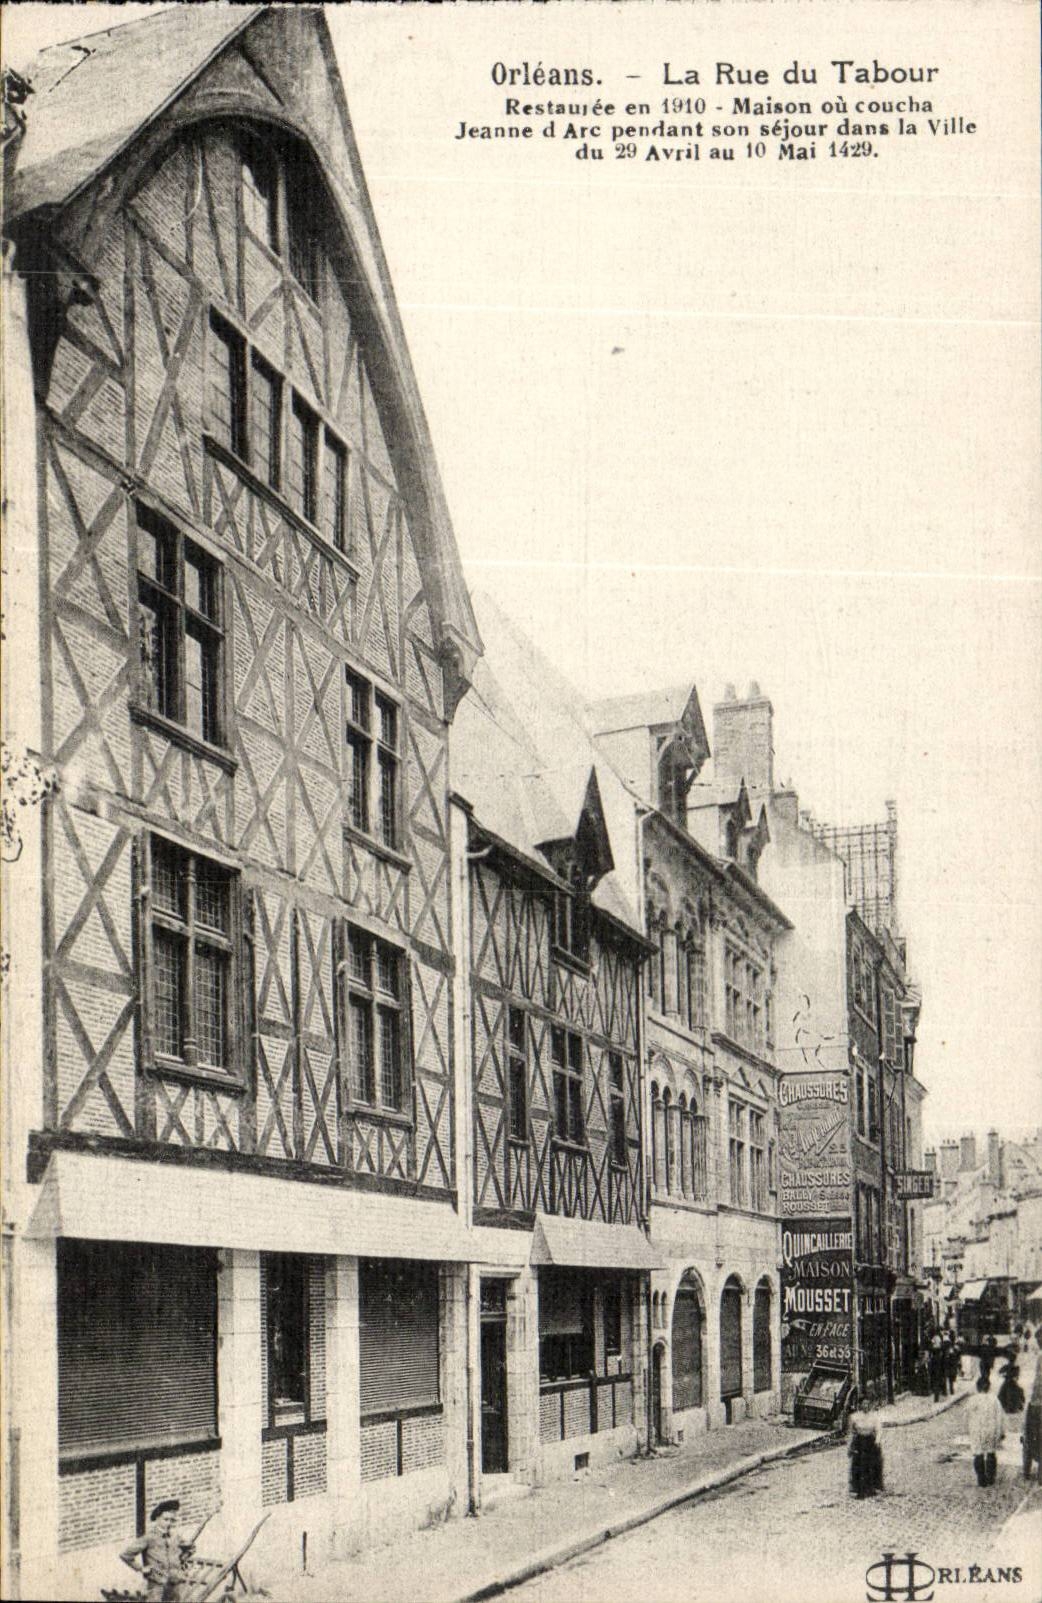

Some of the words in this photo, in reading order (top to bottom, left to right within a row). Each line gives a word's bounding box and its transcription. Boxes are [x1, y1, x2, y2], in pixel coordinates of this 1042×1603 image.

[780, 1080, 848, 1106] CHAUSSURES
[782, 1170, 850, 1188] CHAUSSURES
[783, 1201, 830, 1214] ROUSSET
[783, 1231, 853, 1267] QUINCAILLERIE
[789, 1260, 850, 1280] MAISON
[784, 1283, 851, 1316] MOUSSET
[823, 1321, 849, 1338] FACE
